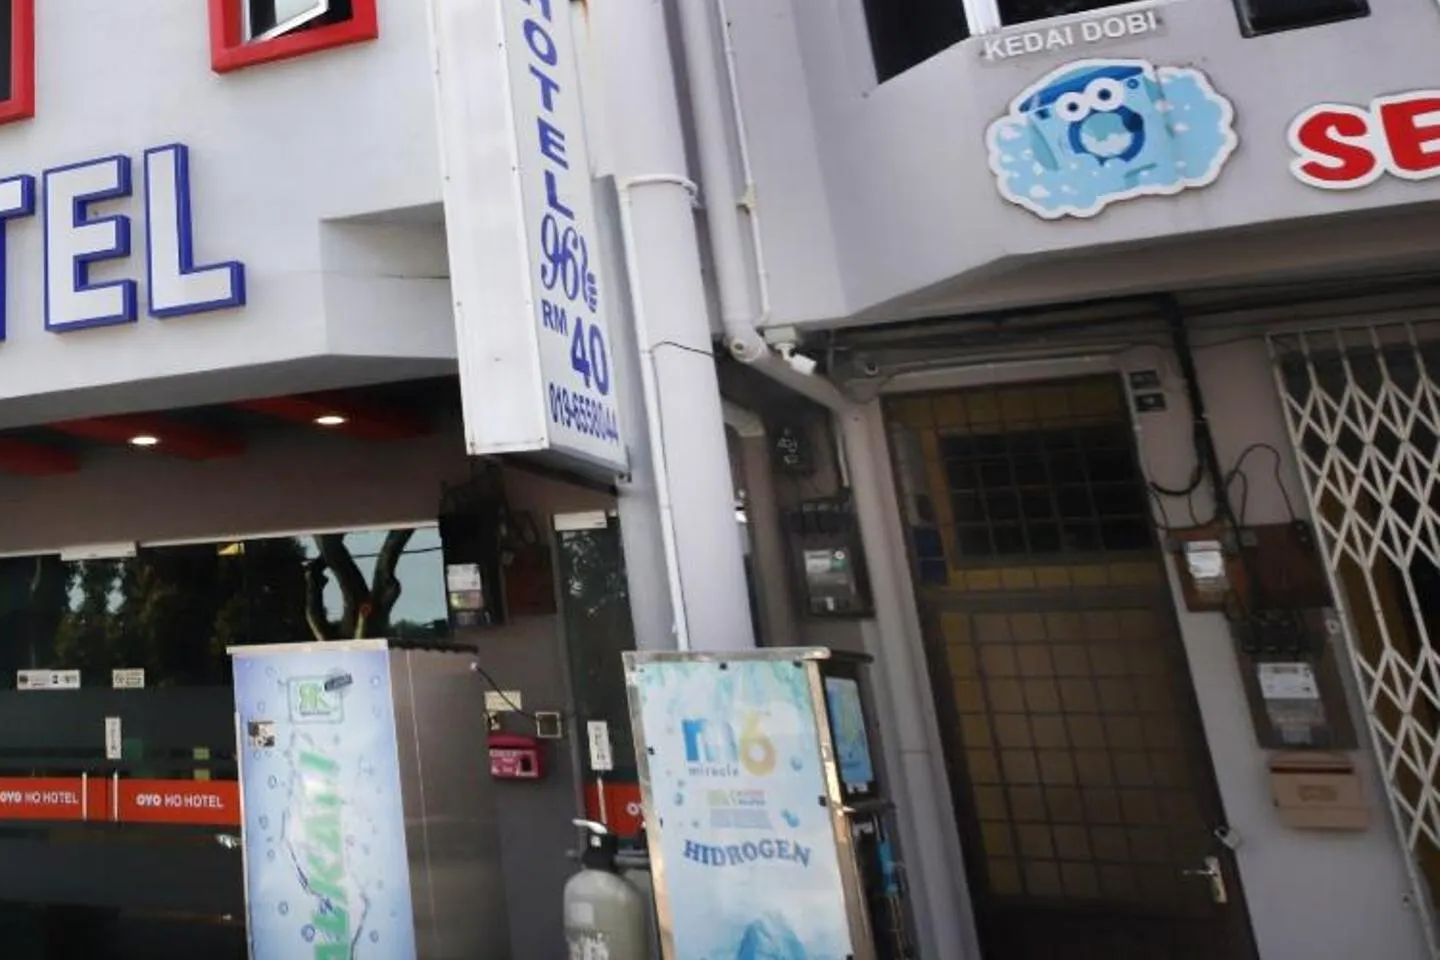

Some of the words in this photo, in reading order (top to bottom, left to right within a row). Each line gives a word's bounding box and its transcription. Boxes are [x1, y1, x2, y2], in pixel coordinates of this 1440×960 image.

[984, 25, 1076, 60] KEDAI
[1082, 10, 1158, 43] DOBI
[542, 298, 568, 337] RM
[571, 316, 610, 396] 40
[0, 791, 22, 803] OYO
[42, 792, 79, 805] HOTEL
[135, 793, 161, 807] OYO
[184, 795, 224, 809] HOTEL
[684, 838, 811, 868] HIDROGEN
